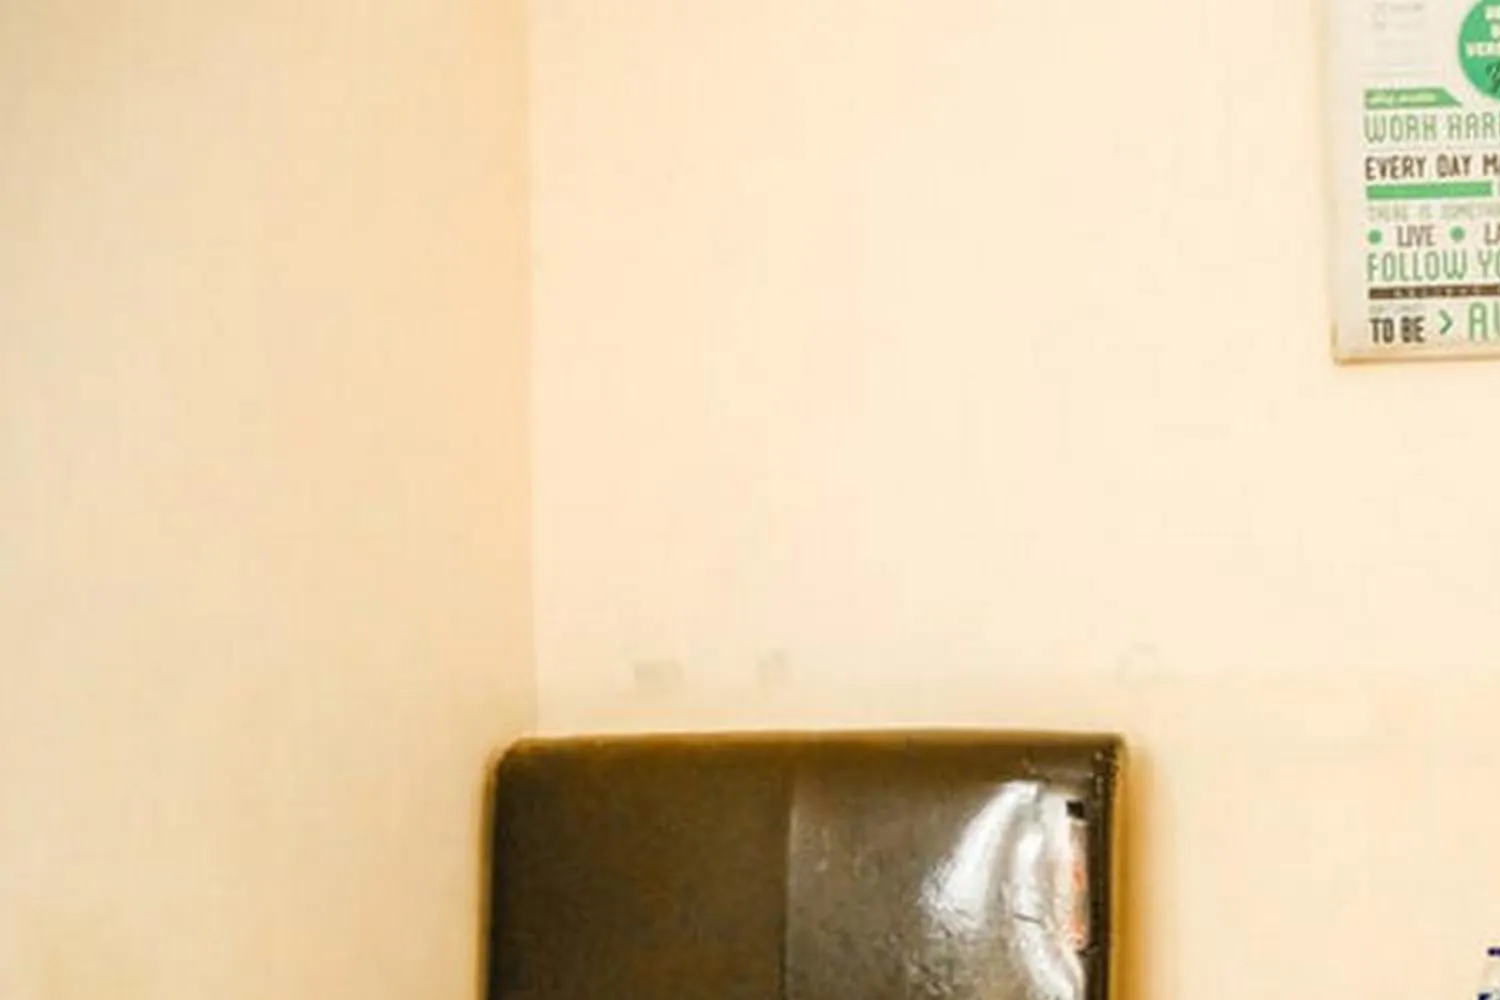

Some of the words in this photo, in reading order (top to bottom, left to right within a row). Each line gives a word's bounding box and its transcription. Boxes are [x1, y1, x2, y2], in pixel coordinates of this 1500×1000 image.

[1364, 113, 1437, 143] WORK
[1365, 154, 1426, 181] EVERY
[1436, 153, 1473, 178] DAY
[1397, 224, 1436, 247] LIVE
[1367, 249, 1467, 282] FOLLOW
[1370, 316, 1394, 343] TO
[1400, 315, 1427, 343] BE
